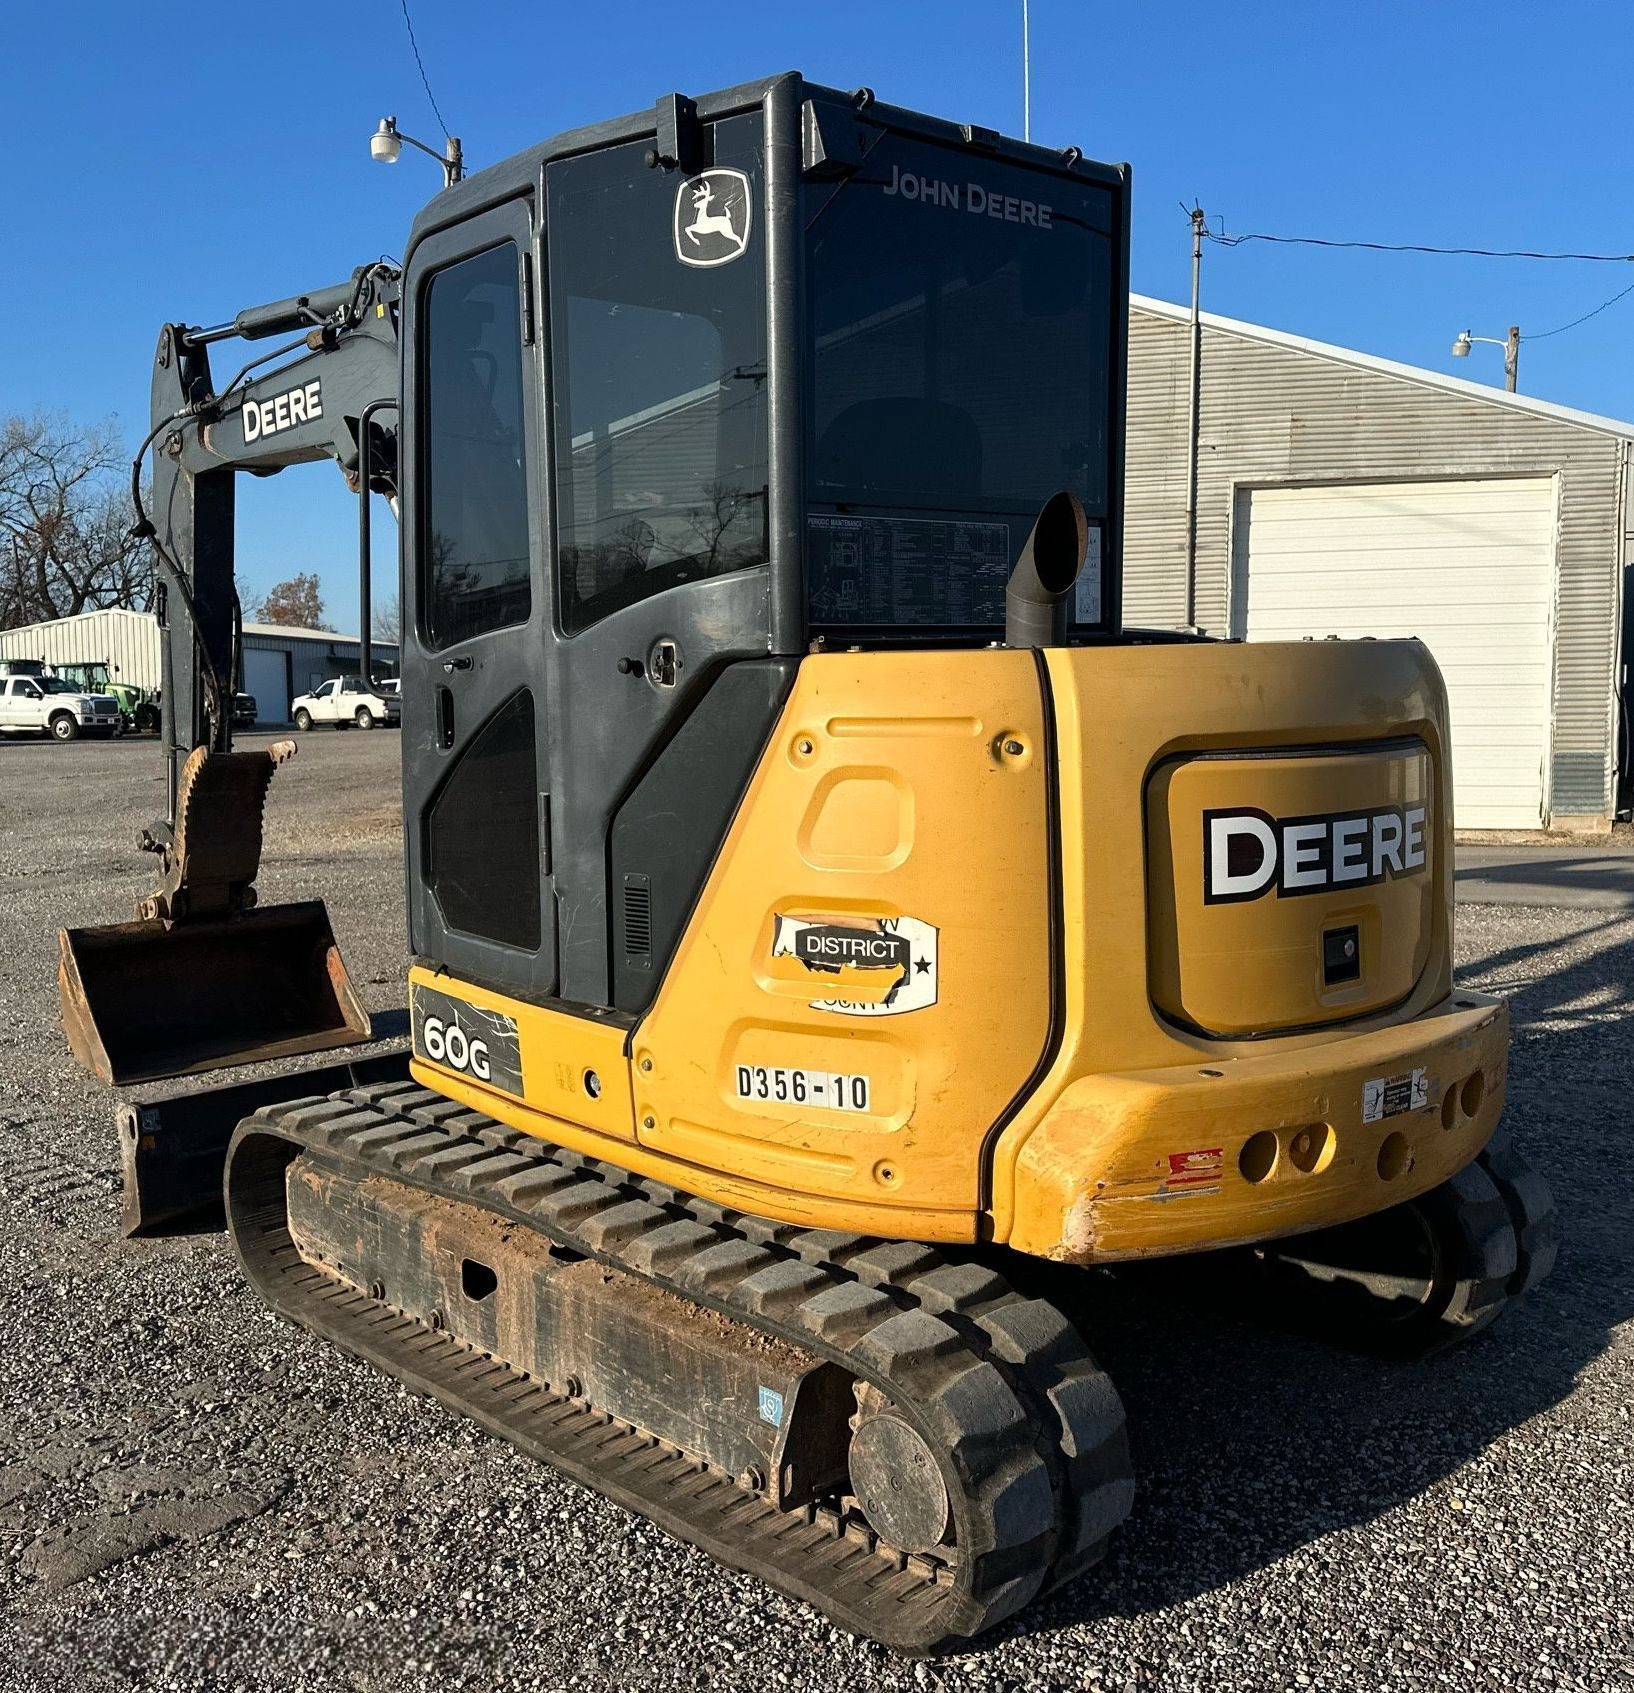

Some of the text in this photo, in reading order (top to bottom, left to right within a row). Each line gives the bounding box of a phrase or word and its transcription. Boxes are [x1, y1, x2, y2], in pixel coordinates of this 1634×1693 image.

[883, 165, 1053, 229] JOHN DEERE
[242, 381, 322, 442] DEERE
[1210, 807, 1425, 896] DEERE
[806, 935, 899, 959] DISTRICT
[424, 1016, 490, 1081] 60G
[738, 1066, 867, 1110] D356-10
